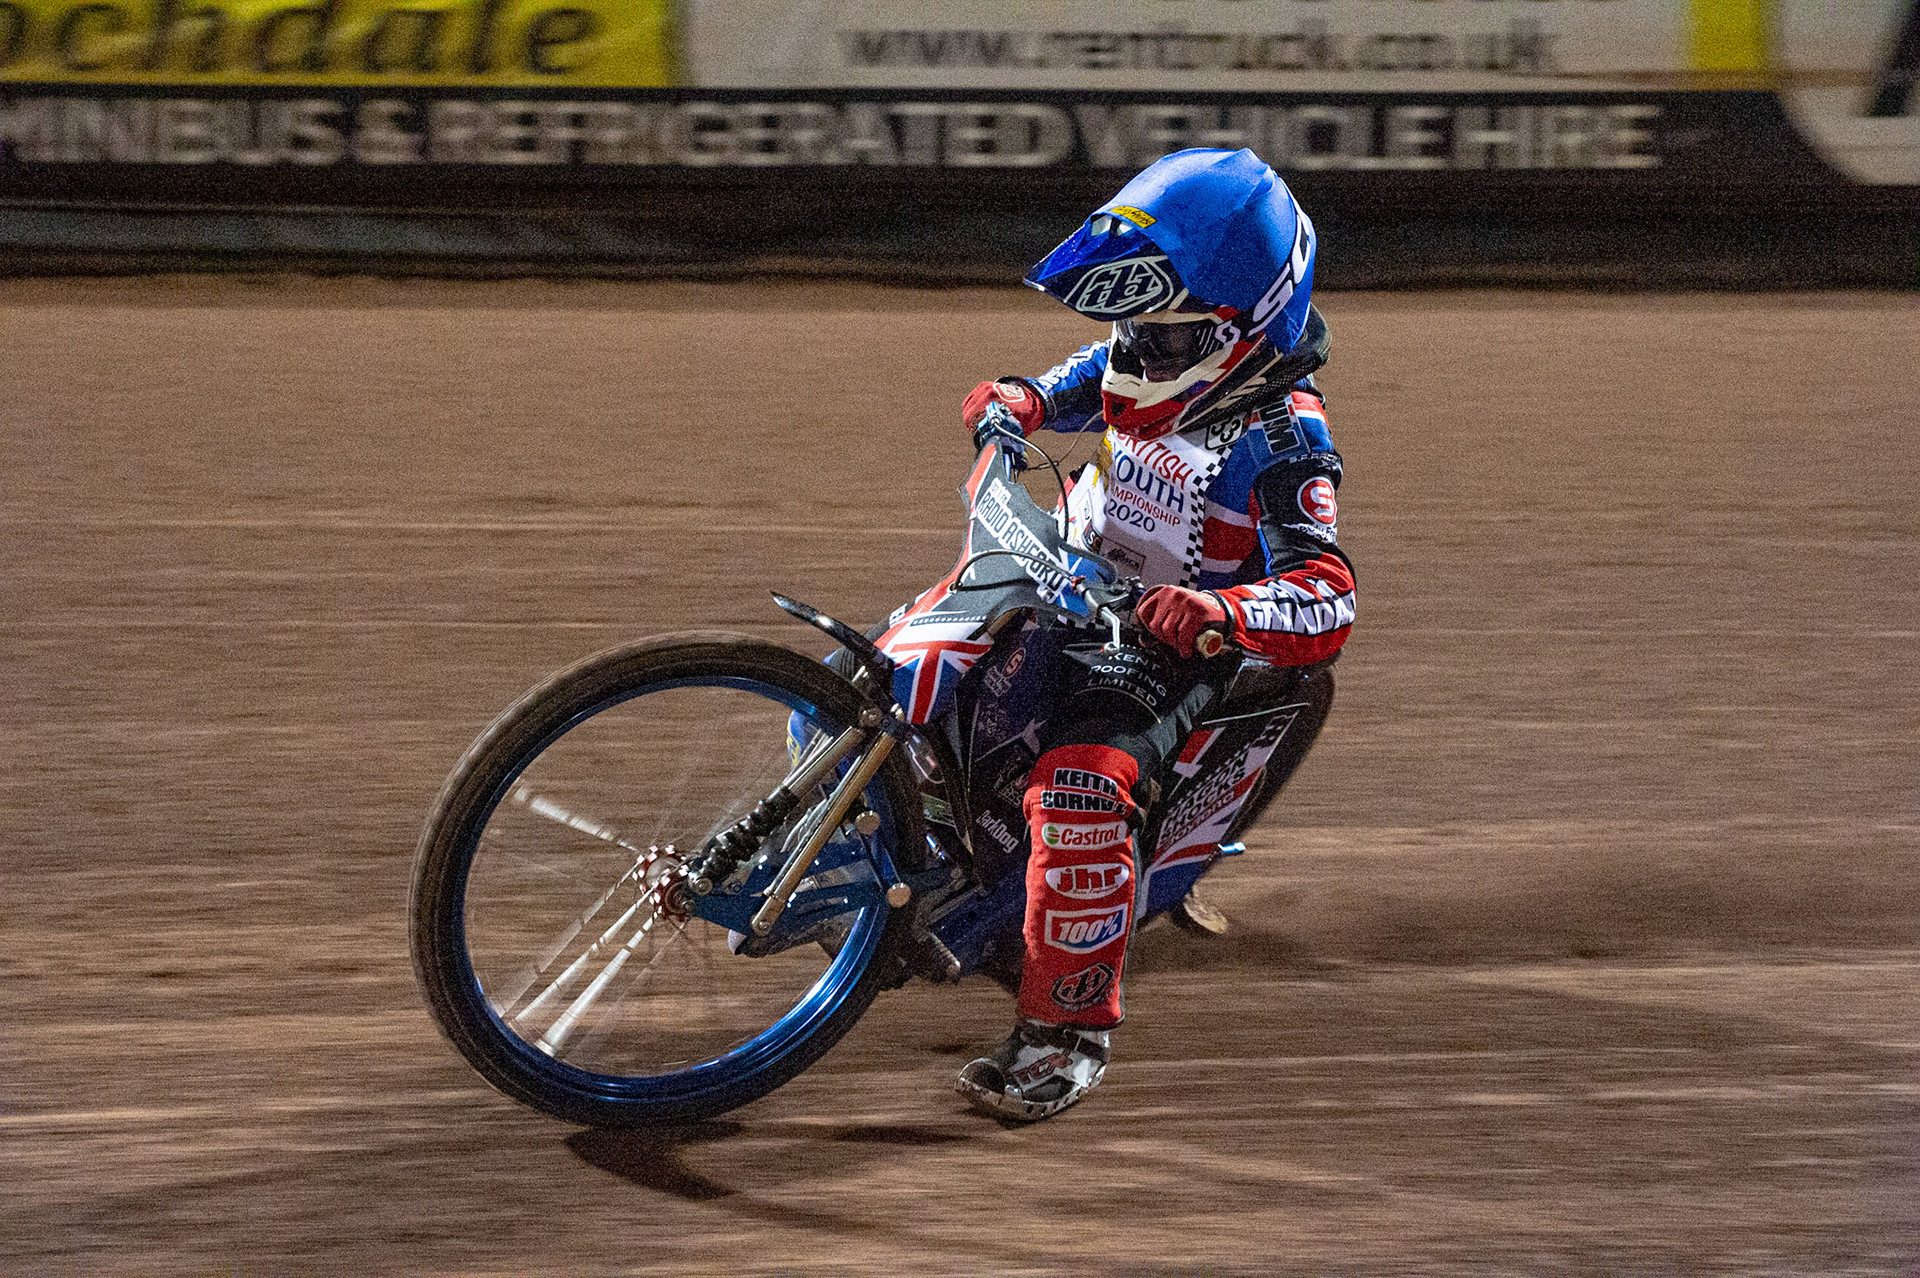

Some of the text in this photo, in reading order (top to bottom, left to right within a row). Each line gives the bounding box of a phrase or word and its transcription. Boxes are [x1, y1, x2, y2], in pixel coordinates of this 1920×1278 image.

[433, 98, 1066, 168] REFRIGERATED
[1079, 101, 1445, 169] VEHICLE
[1458, 102, 1657, 169] HIRE
[977, 491, 1010, 533] RADIO
[1107, 498, 1156, 533] 2020
[1108, 652, 1161, 671] KENT
[1087, 678, 1157, 707] LIMITED
[1089, 664, 1168, 697] ROOFING
[1054, 769, 1118, 798] KEITH
[1061, 823, 1120, 846] Castrol
[1056, 865, 1123, 893] jhr
[1057, 912, 1120, 944] 100%
